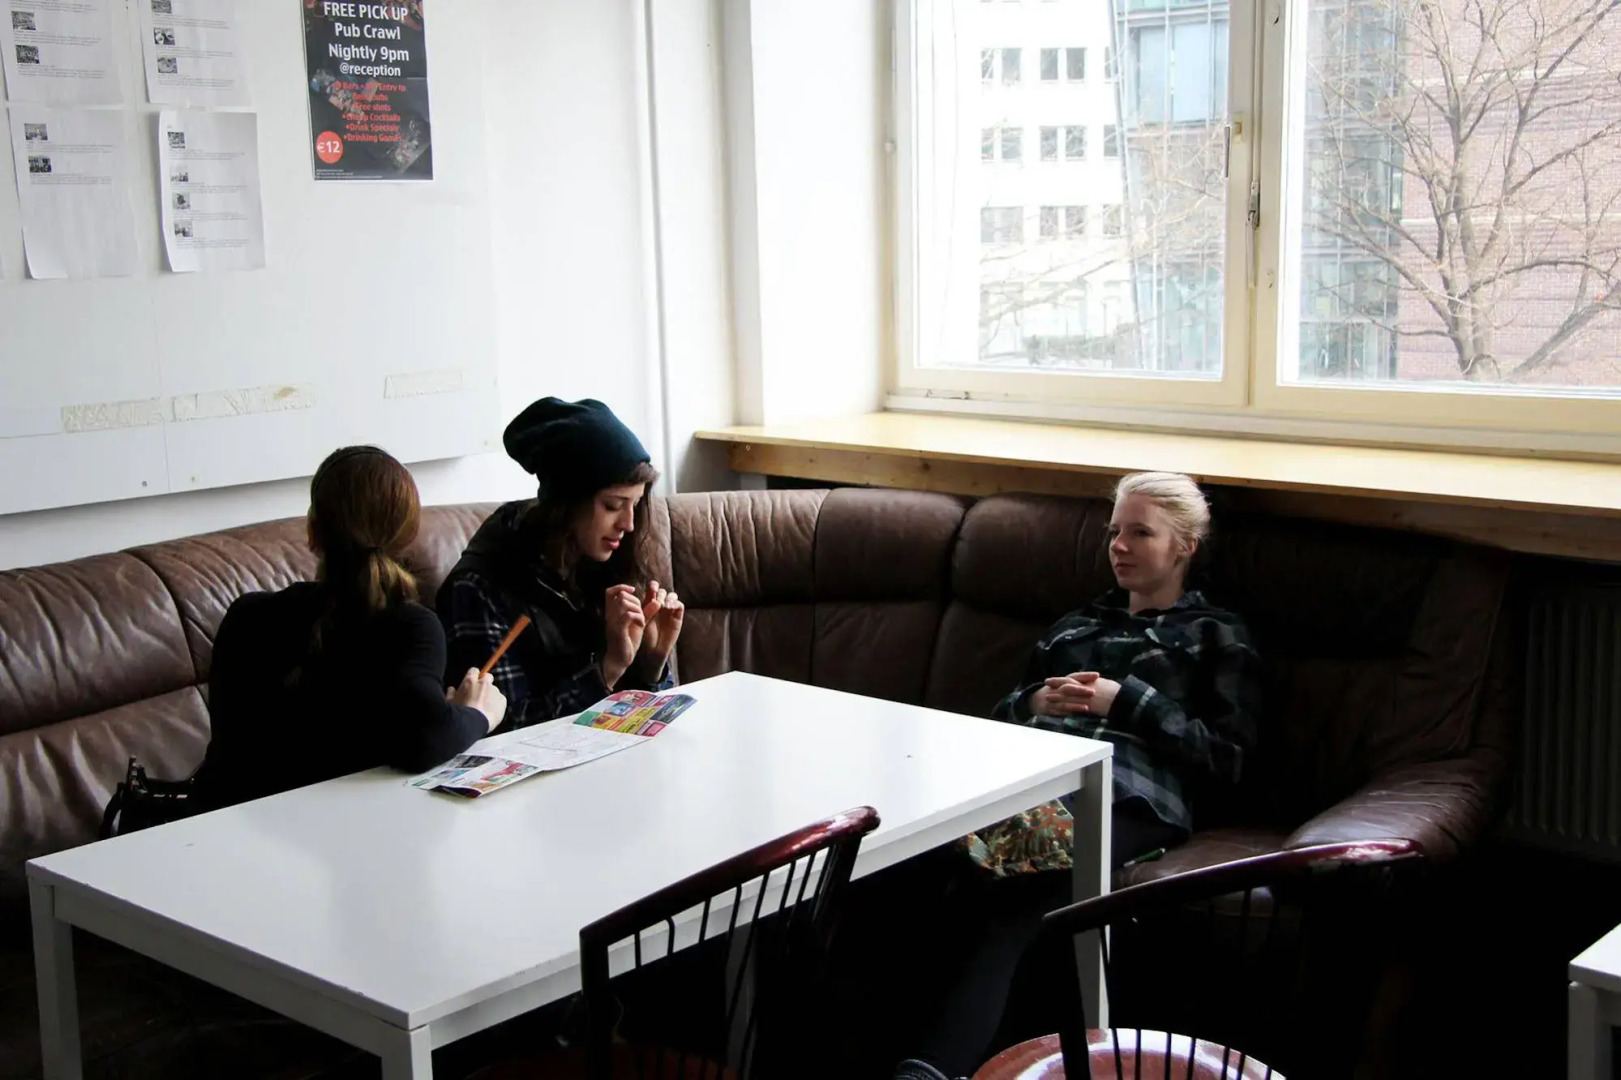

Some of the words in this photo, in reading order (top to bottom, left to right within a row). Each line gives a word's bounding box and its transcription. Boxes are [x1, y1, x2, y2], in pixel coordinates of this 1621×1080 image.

[323, 2, 355, 17] FREE
[358, 4, 389, 20] PICK
[392, 7, 408, 21] UP
[334, 22, 360, 37] Pub
[363, 24, 400, 40] Crawl
[328, 43, 377, 62] Nightly
[381, 46, 409, 63] 9pm
[340, 62, 401, 77] @reception
[379, 84, 398, 92] Entry
[398, 83, 406, 92] to
[316, 141, 340, 153] €12
